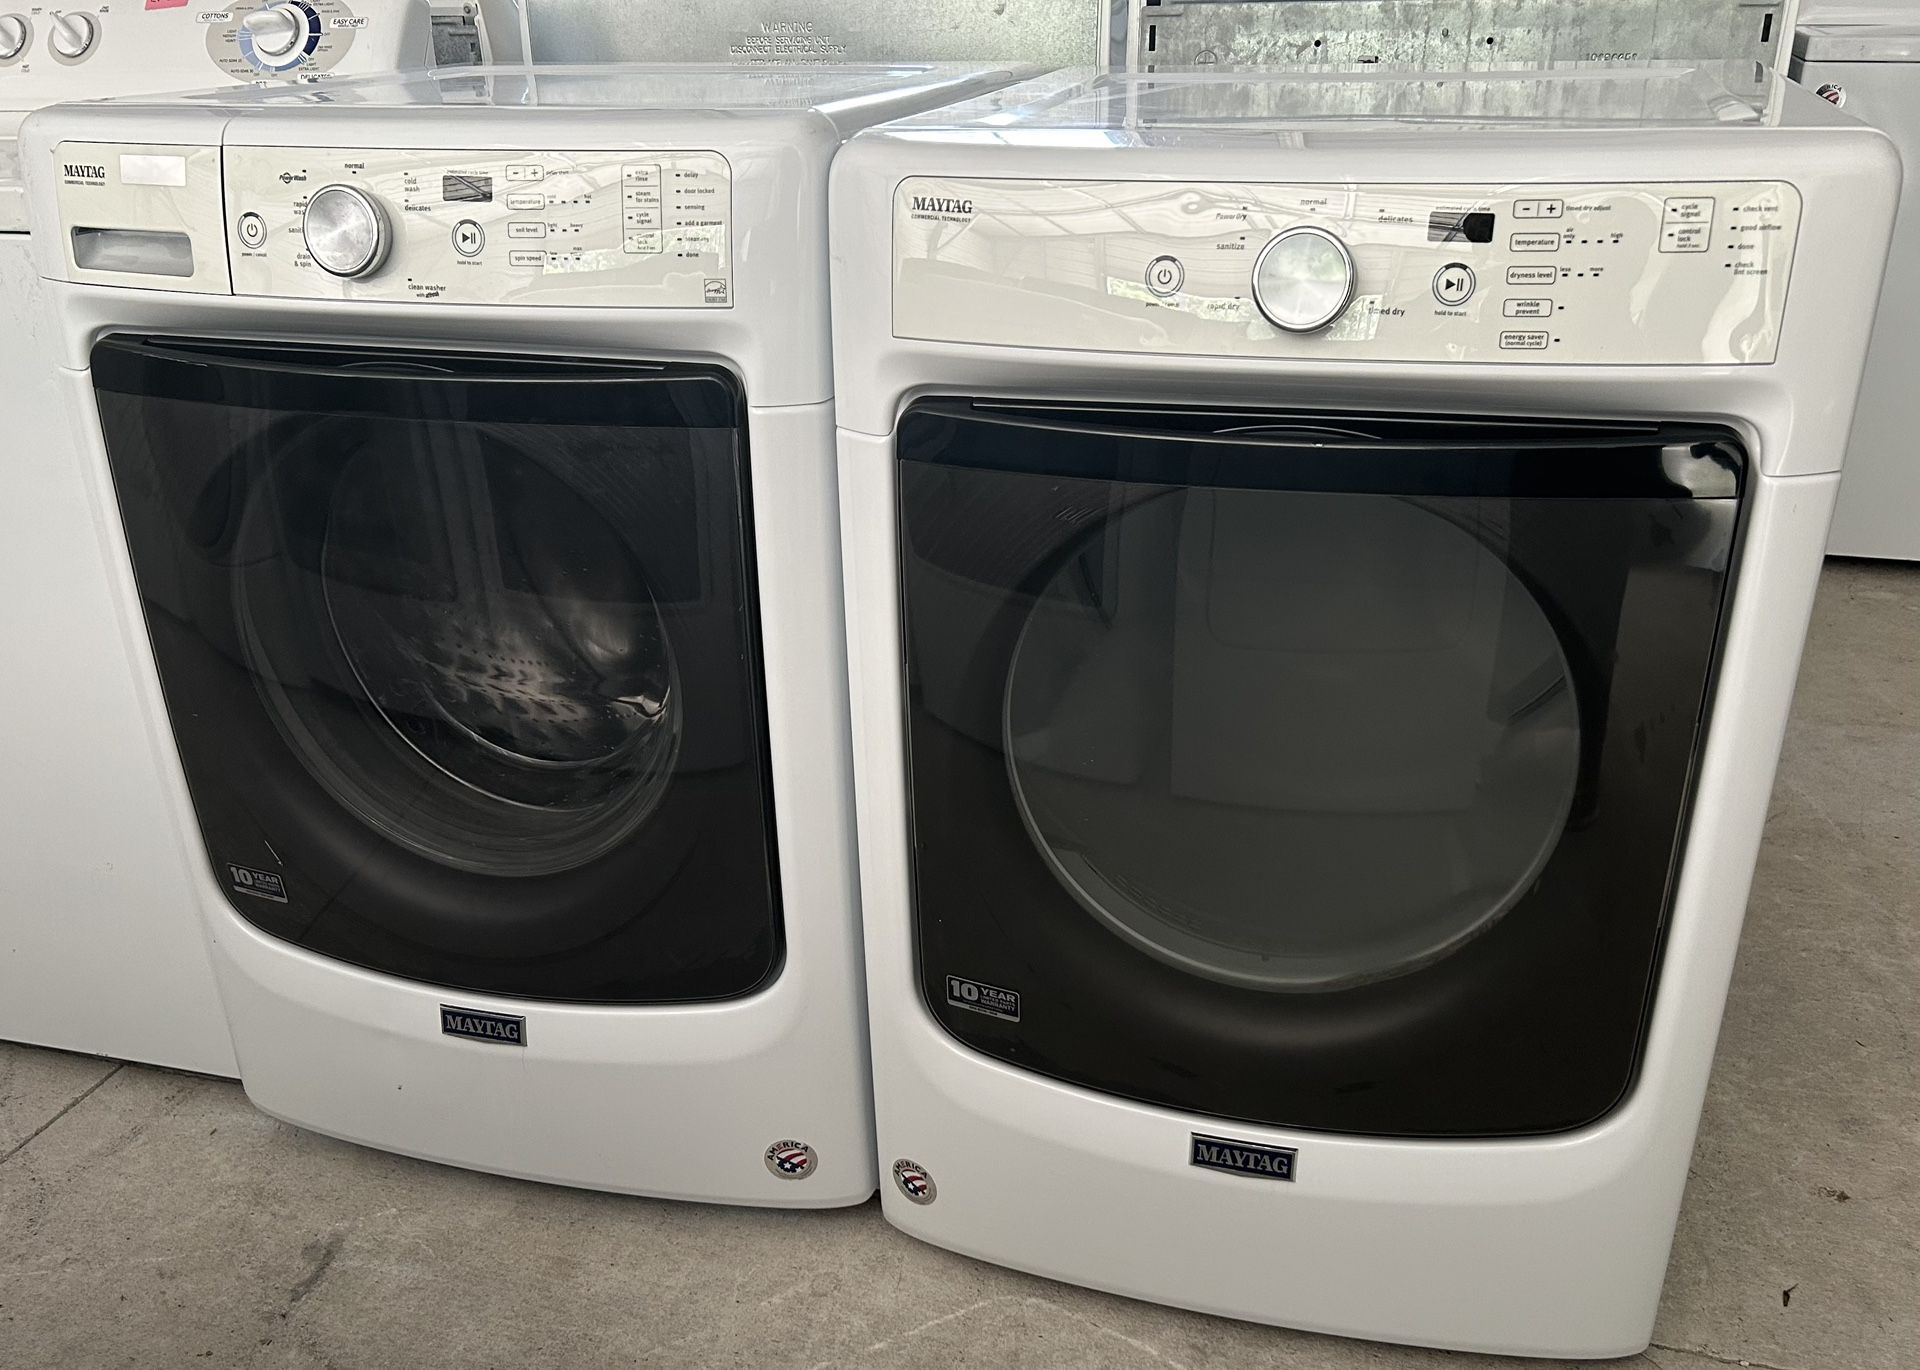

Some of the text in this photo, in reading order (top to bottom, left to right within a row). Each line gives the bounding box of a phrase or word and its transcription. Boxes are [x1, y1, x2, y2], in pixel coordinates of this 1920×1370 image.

[761, 21, 813, 34] WARNING
[745, 36, 830, 45] BEFORE SERVICING UNIT
[730, 45, 847, 55] DISCONNECT ELECTRICAL SUPPLY
[63, 165, 105, 178] MAYTAG
[912, 196, 974, 214] MAYTAG
[1300, 198, 1328, 206] normal
[404, 203, 431, 212] delicates
[1378, 215, 1414, 223] delicates
[1680, 211, 1701, 219] signal
[700, 219, 722, 227] garment
[1514, 239, 1555, 247] temperature
[1227, 303, 1240, 311] dry
[1392, 308, 1405, 317] dry
[1515, 308, 1540, 316] prevent
[1526, 339, 1542, 347] cycle)
[230, 866, 279, 885] 10 YEAR
[950, 979, 979, 1001] 10
[980, 987, 1016, 1003] YEAR
[445, 1014, 519, 1039] MAYTAG
[767, 1141, 809, 1161] AMERICA
[1196, 1143, 1289, 1174] MAYTAG
[895, 1160, 928, 1179] AMERICA
